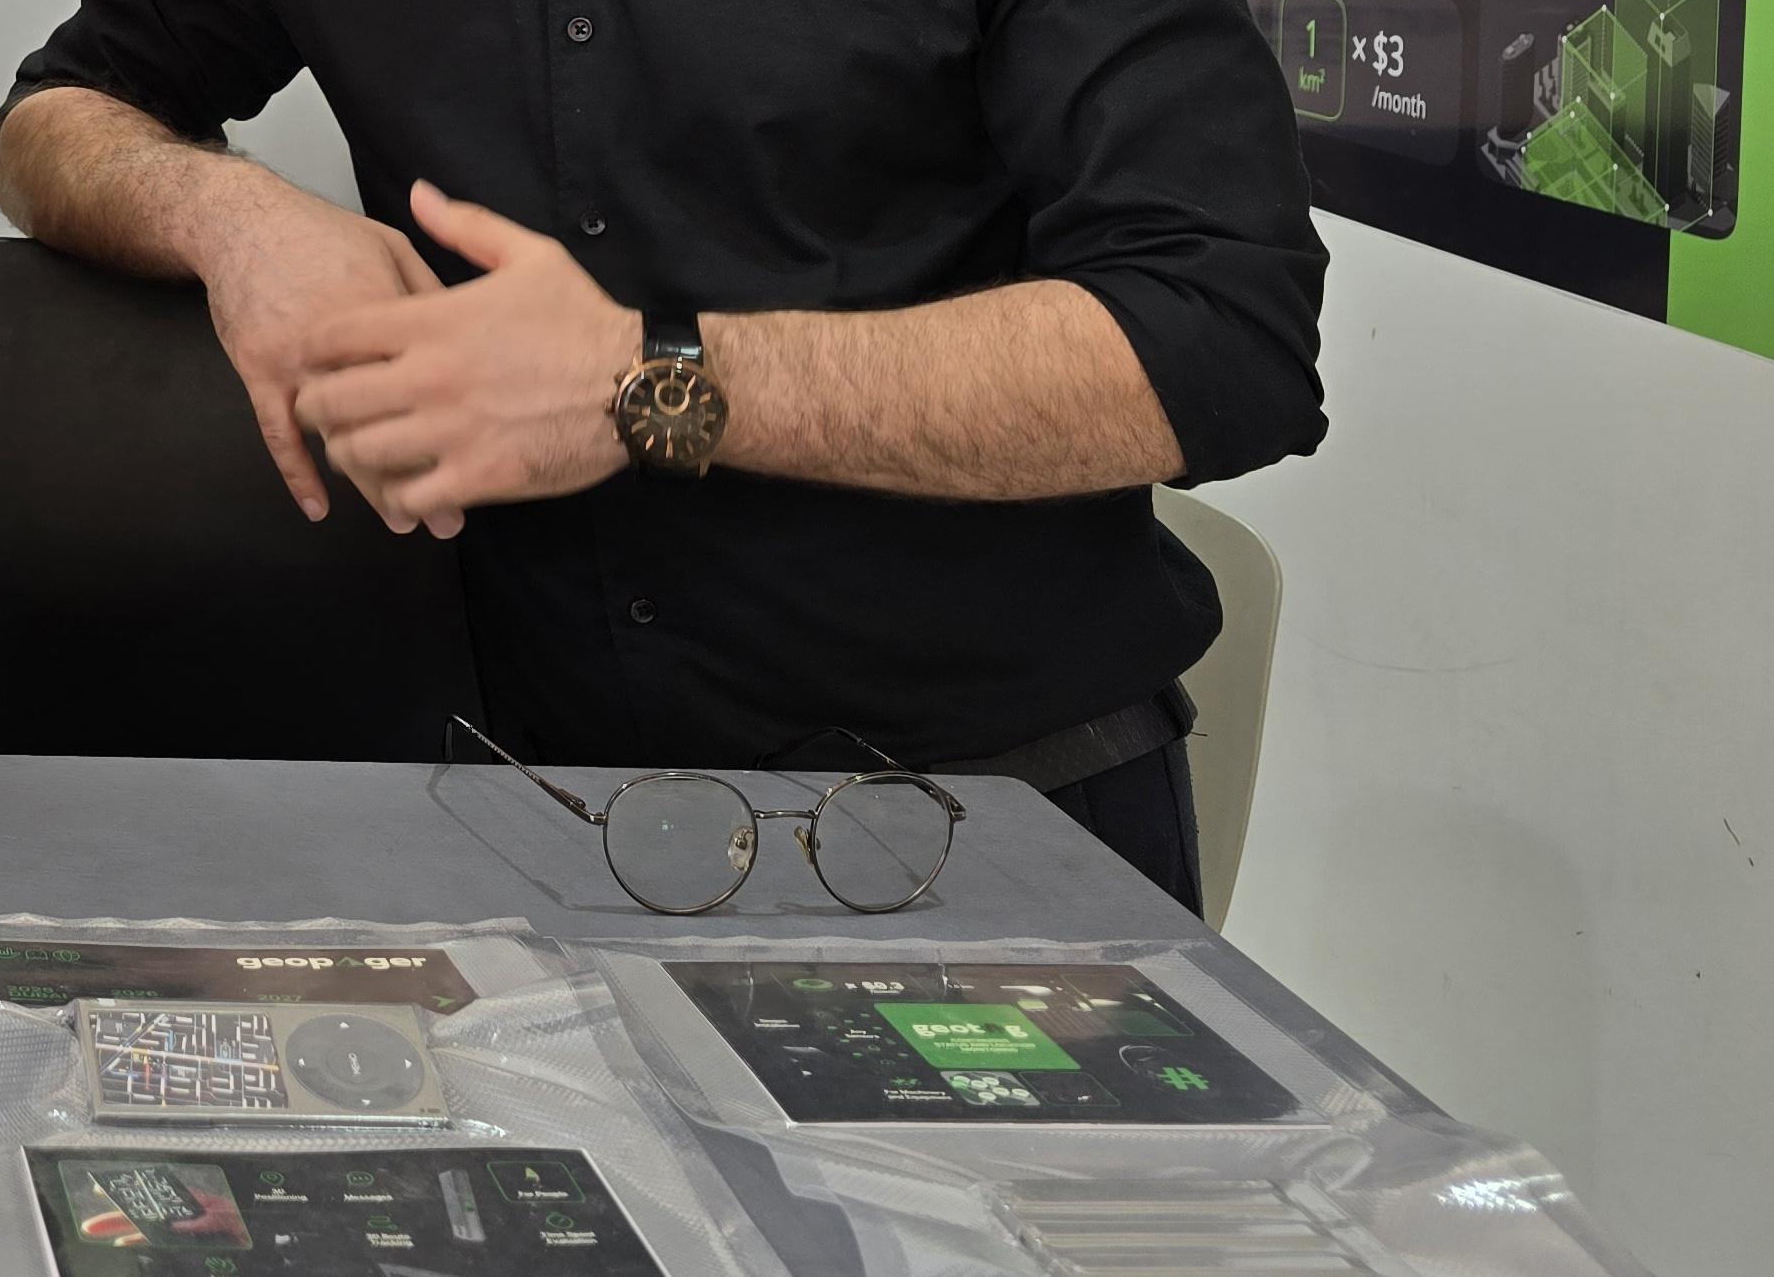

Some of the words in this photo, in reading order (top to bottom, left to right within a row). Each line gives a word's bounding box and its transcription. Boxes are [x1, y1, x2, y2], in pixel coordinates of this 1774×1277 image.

[1305, 19, 1317, 60] 1
[1372, 30, 1405, 78] $3
[1371, 85, 1427, 120] /month
